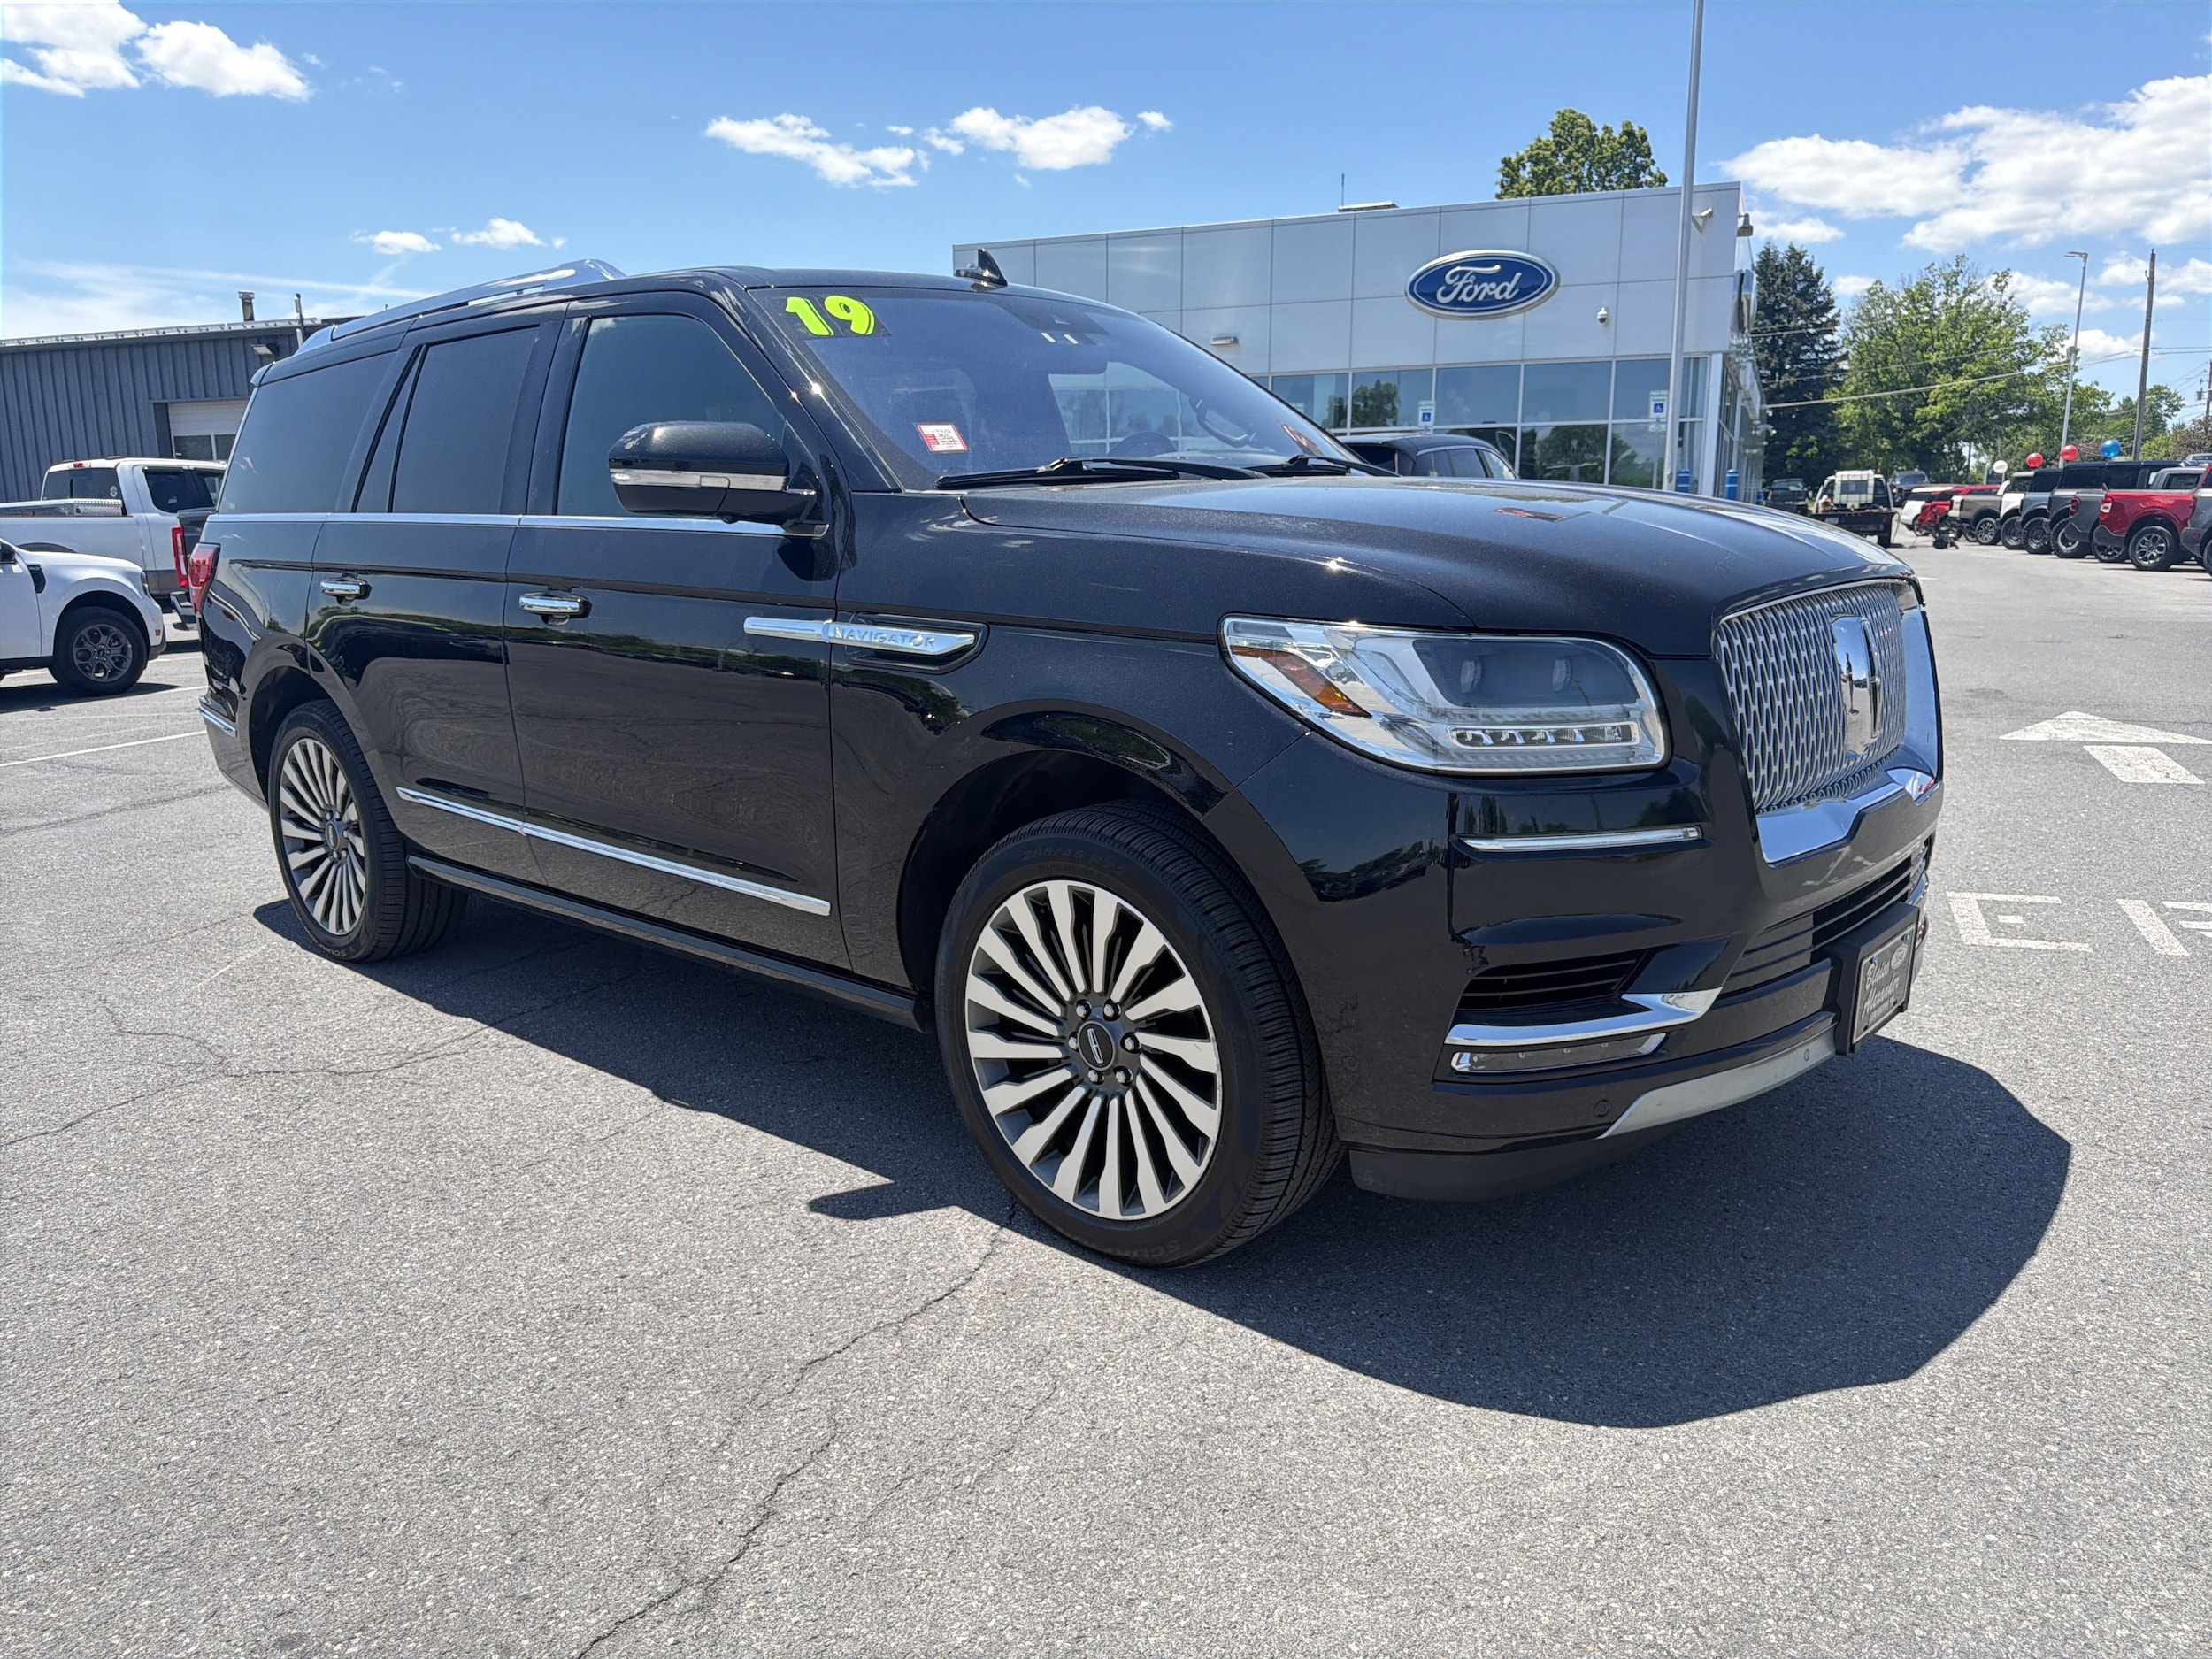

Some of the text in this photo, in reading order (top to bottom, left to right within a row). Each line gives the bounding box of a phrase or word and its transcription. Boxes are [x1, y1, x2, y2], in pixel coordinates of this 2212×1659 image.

[1436, 265, 1522, 303] Ford
[786, 295, 875, 335] 19
[834, 626, 935, 649] NAVIGATOR
